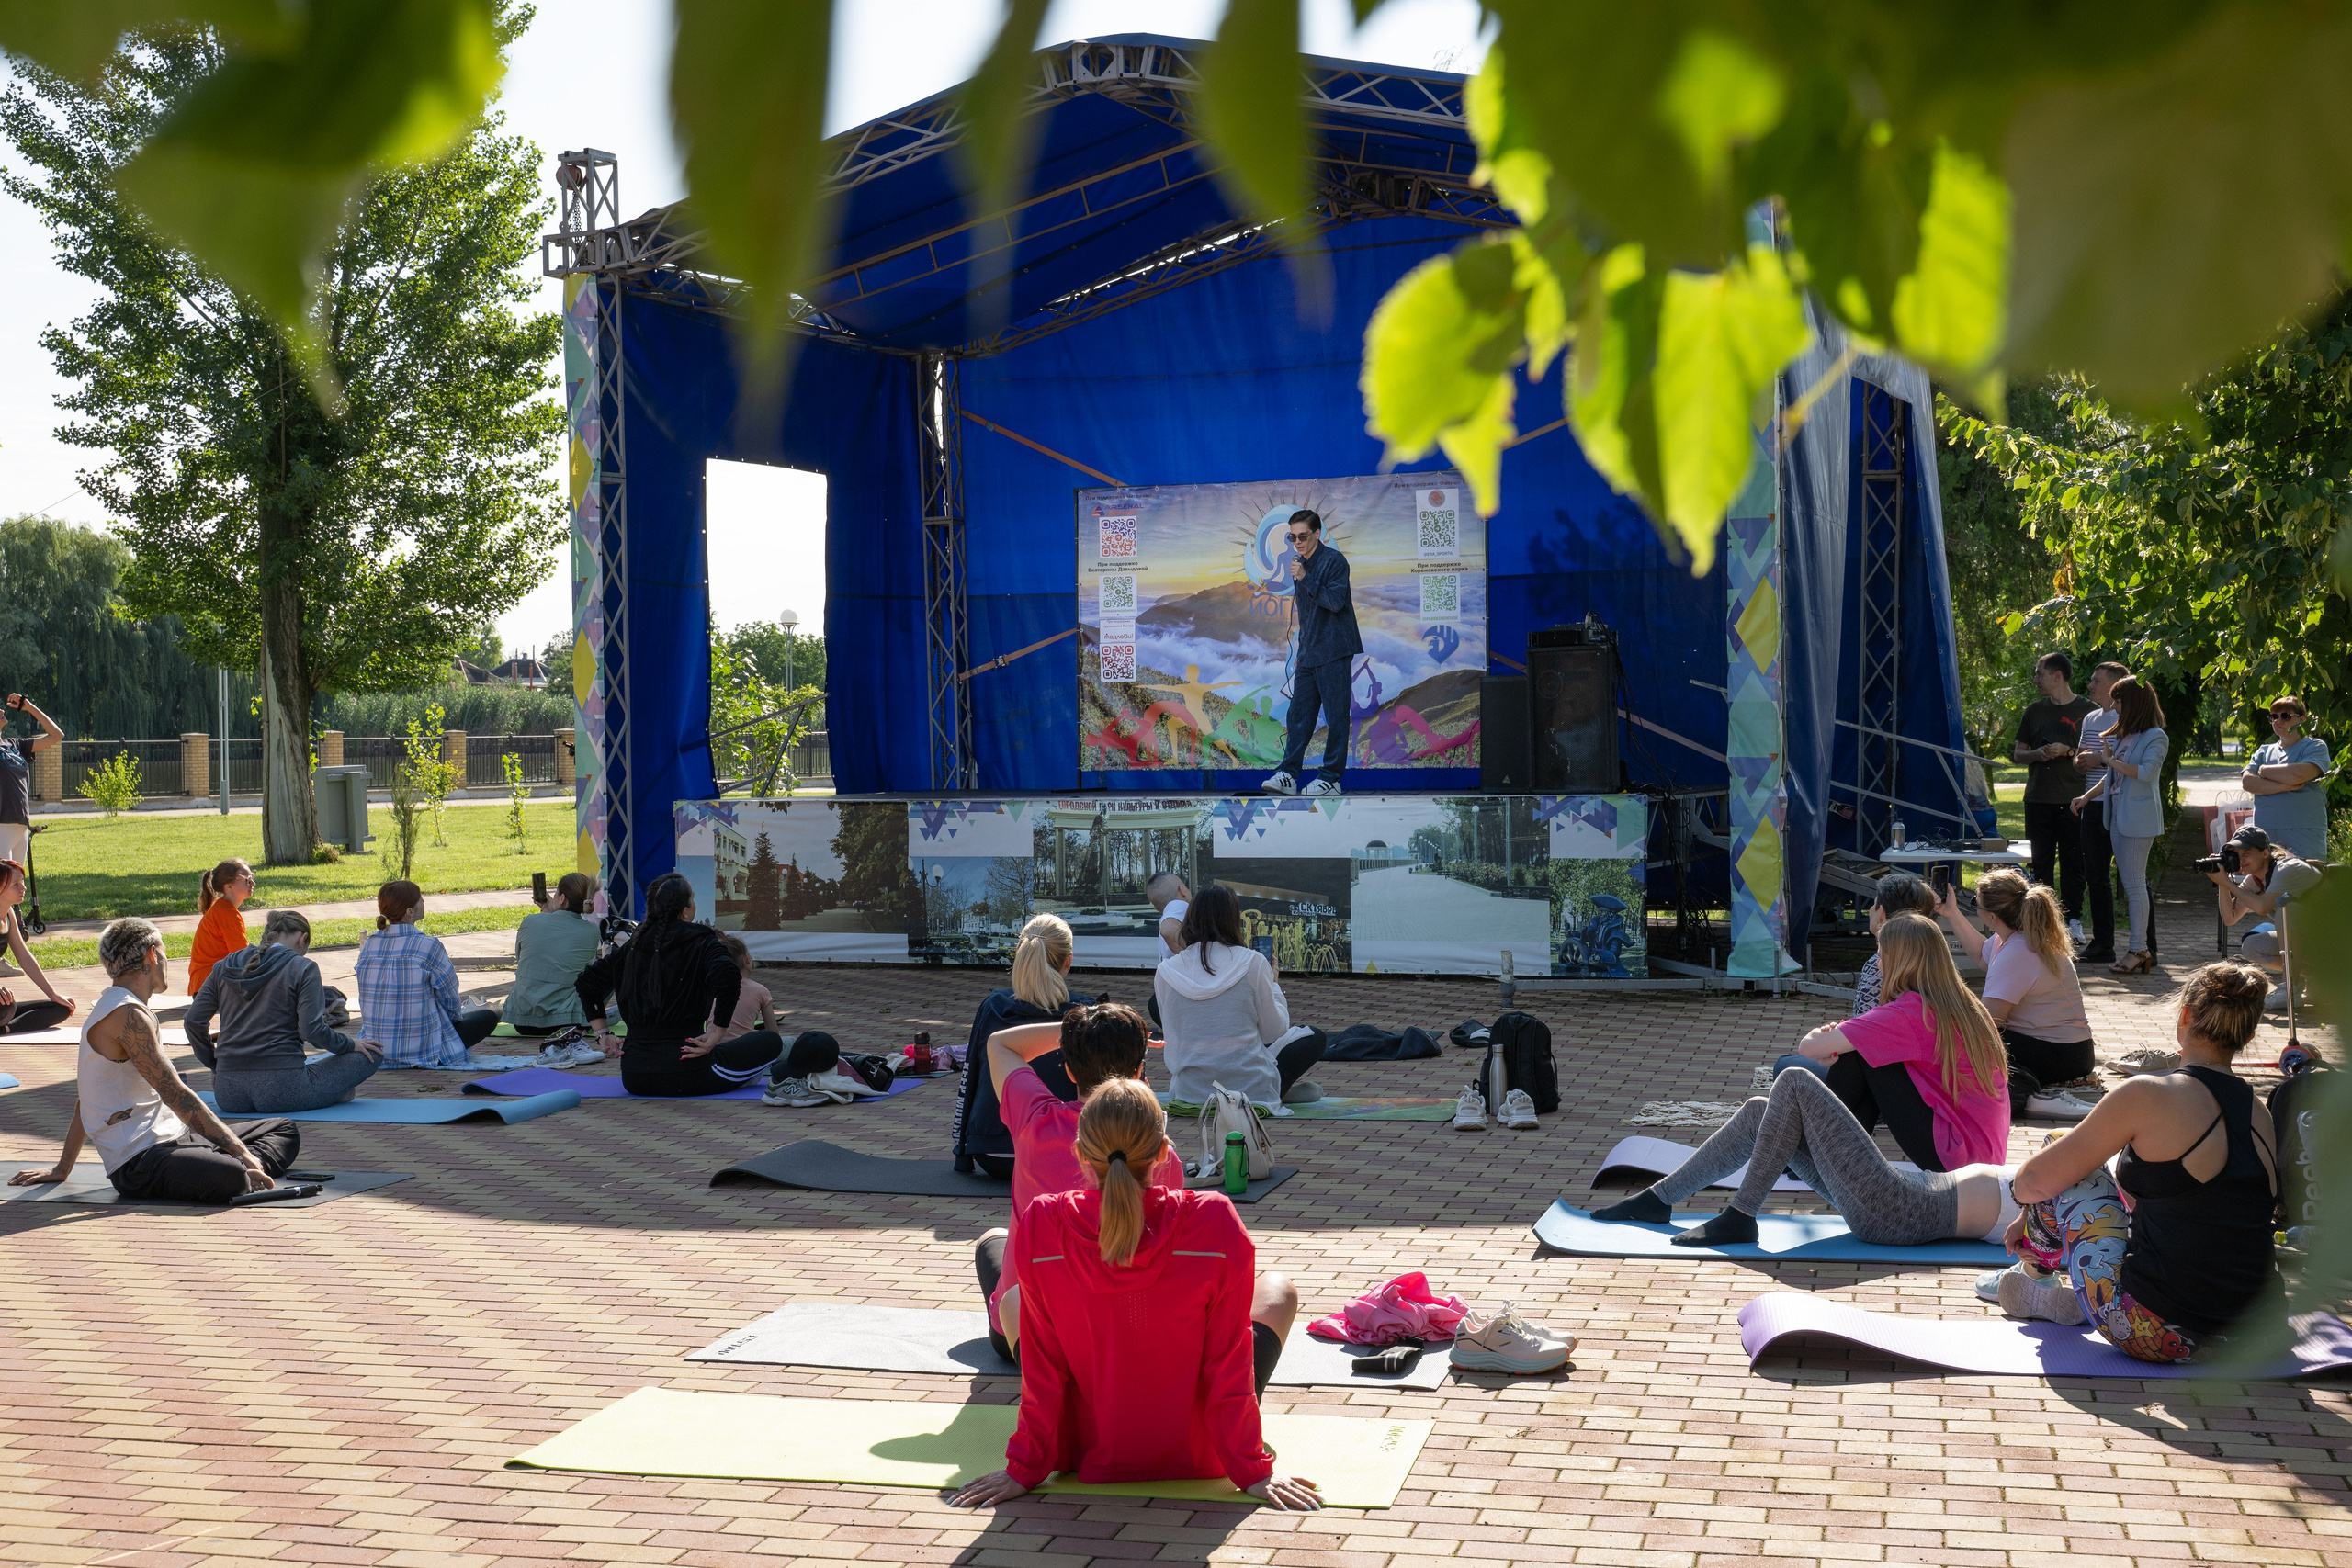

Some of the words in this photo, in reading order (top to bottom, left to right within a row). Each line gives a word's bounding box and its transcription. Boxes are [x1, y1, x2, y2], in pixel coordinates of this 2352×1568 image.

[1057, 799, 1097, 811] ГОРОДСКОЙ
[1117, 800, 1153, 812] КУЛЬТУРЫ
[960, 1062, 969, 1093] KEEP
